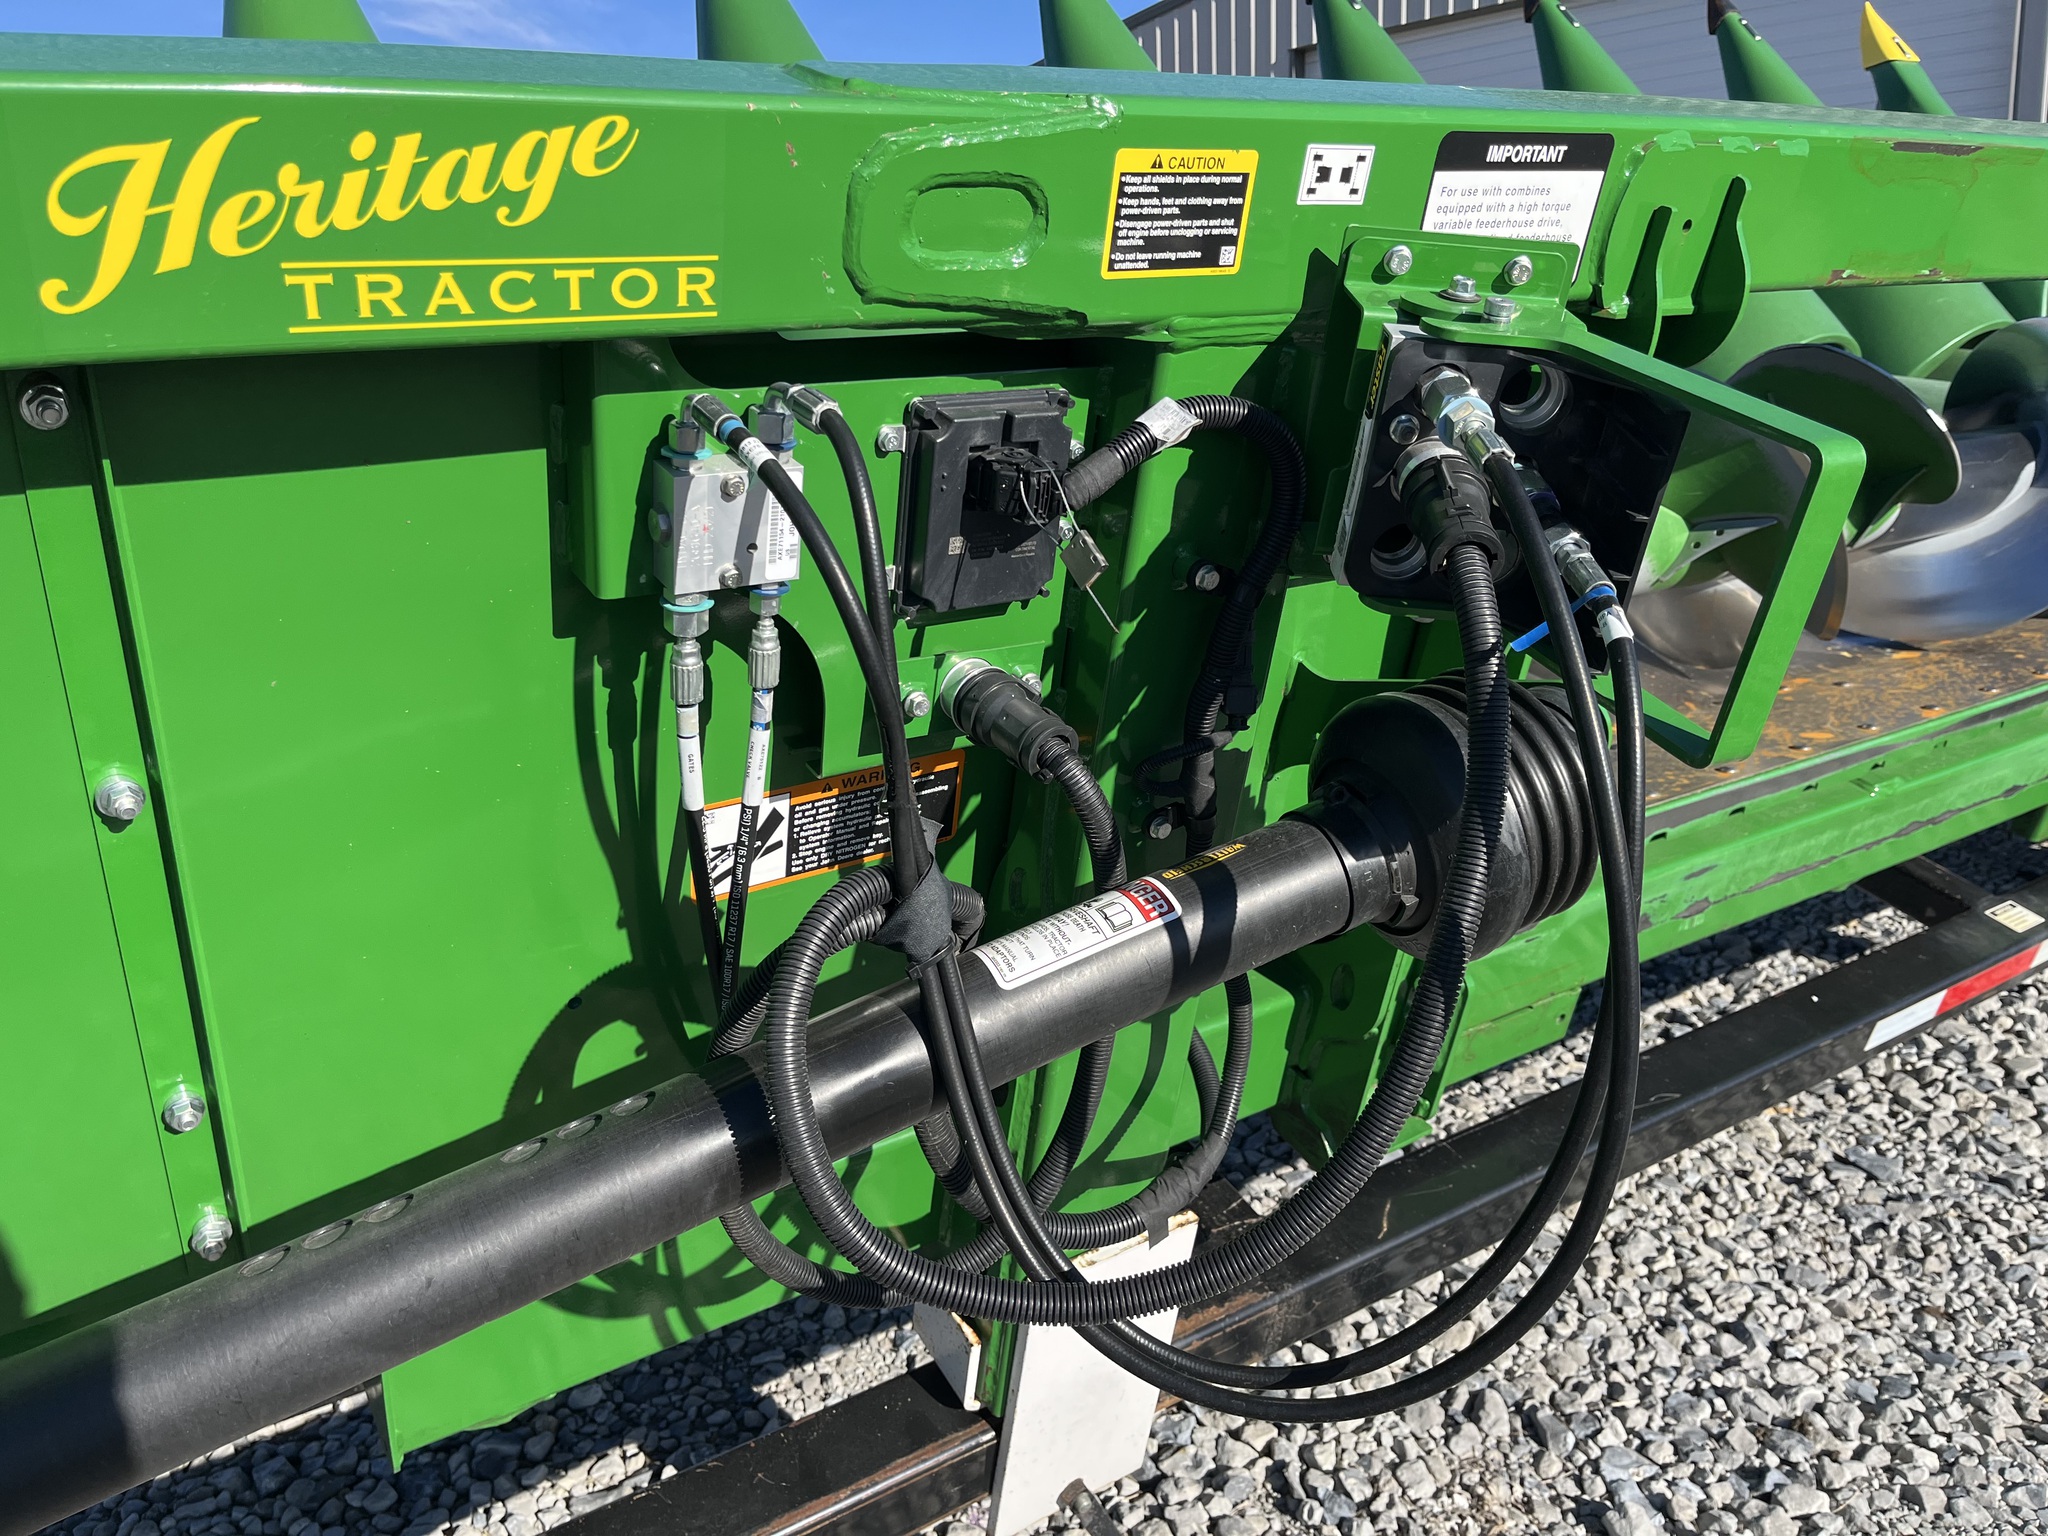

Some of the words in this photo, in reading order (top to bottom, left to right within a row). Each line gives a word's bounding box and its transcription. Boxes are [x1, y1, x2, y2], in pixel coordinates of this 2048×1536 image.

[1486, 145, 1568, 163] IMPORTANT
[1168, 156, 1225, 170] CAUTION
[1126, 175, 1142, 184] Keep
[1143, 175, 1151, 183] all
[1152, 175, 1175, 183] shields
[1176, 175, 1182, 183] in
[1183, 175, 1199, 185] place
[1201, 175, 1220, 185] during
[1222, 175, 1242, 183] normal
[1124, 185, 1159, 193] operations.
[1441, 186, 1458, 197] For
[1482, 186, 1502, 196] with
[1505, 186, 1551, 196] combines
[1123, 198, 1139, 206] Keep
[1140, 198, 1160, 206] hands,
[1188, 198, 1211, 206] clothing
[1213, 198, 1228, 206] away
[1437, 202, 1482, 216] equipped
[1486, 202, 1506, 212] with
[1509, 204, 1514, 212] a
[1517, 202, 1538, 214] high
[1541, 202, 1571, 214] torque
[39, 114, 640, 315] Heritage
[1121, 207, 1161, 216] power-driven
[1163, 207, 1180, 216] parts.
[1120, 220, 1151, 228] Disengage
[1153, 219, 1191, 228] power-driven
[1193, 219, 1207, 228] parts
[1221, 218, 1234, 226] shut
[1433, 219, 1472, 230] variable
[1476, 218, 1534, 229] feederhouse
[1537, 217, 1563, 228] drive,
[1119, 229, 1127, 237] off
[1128, 229, 1148, 238] engine
[1150, 228, 1169, 236] before
[1170, 228, 1203, 237] unclogging
[1212, 228, 1238, 236] servicing
[1117, 238, 1145, 246] machine.
[1136, 252, 1152, 260] leave
[1153, 251, 1175, 260] running
[1114, 261, 1149, 269] unattended.
[285, 267, 718, 320] TRACTOR
[842, 762, 920, 788] WARG
[795, 803, 812, 811] Avoid
[814, 798, 836, 806] serious
[839, 793, 854, 801] injury
[832, 801, 848, 810] under
[851, 796, 876, 806] pressure.
[740, 807, 751, 825] PSI)
[794, 817, 814, 825] Before
[816, 809, 842, 820] removing
[845, 803, 871, 814] hydraulic
[800, 828, 821, 837] Relieve
[824, 823, 844, 831] system
[847, 816, 872, 825] hydraulic
[803, 820, 830, 830] changing
[808, 832, 833, 842] Operator
[836, 826, 856, 835] Manual
[799, 842, 820, 851] system
[822, 834, 855, 844] information.
[815, 845, 834, 853] engine
[850, 836, 870, 844] remove
[805, 862, 818, 870] your
[838, 853, 854, 861] Deere
[856, 848, 874, 856] dealer.
[806, 855, 818, 863] only
[836, 843, 866, 854] NITROGEN
[733, 863, 743, 883] mm)
[731, 885, 741, 898] ISO
[1123, 879, 1168, 918] NGER
[728, 899, 739, 925] 11237
[1070, 917, 1085, 932] DEATH
[726, 926, 736, 941] R17
[1045, 939, 1061, 958] PLACE
[1048, 930, 1067, 955] TRACTOR
[724, 948, 734, 962] SAE
[991, 943, 1015, 973] ADAPTORS
[1002, 943, 1017, 962] MANUAL
[1023, 945, 1035, 961] TURN
[721, 964, 732, 992] 100R17
